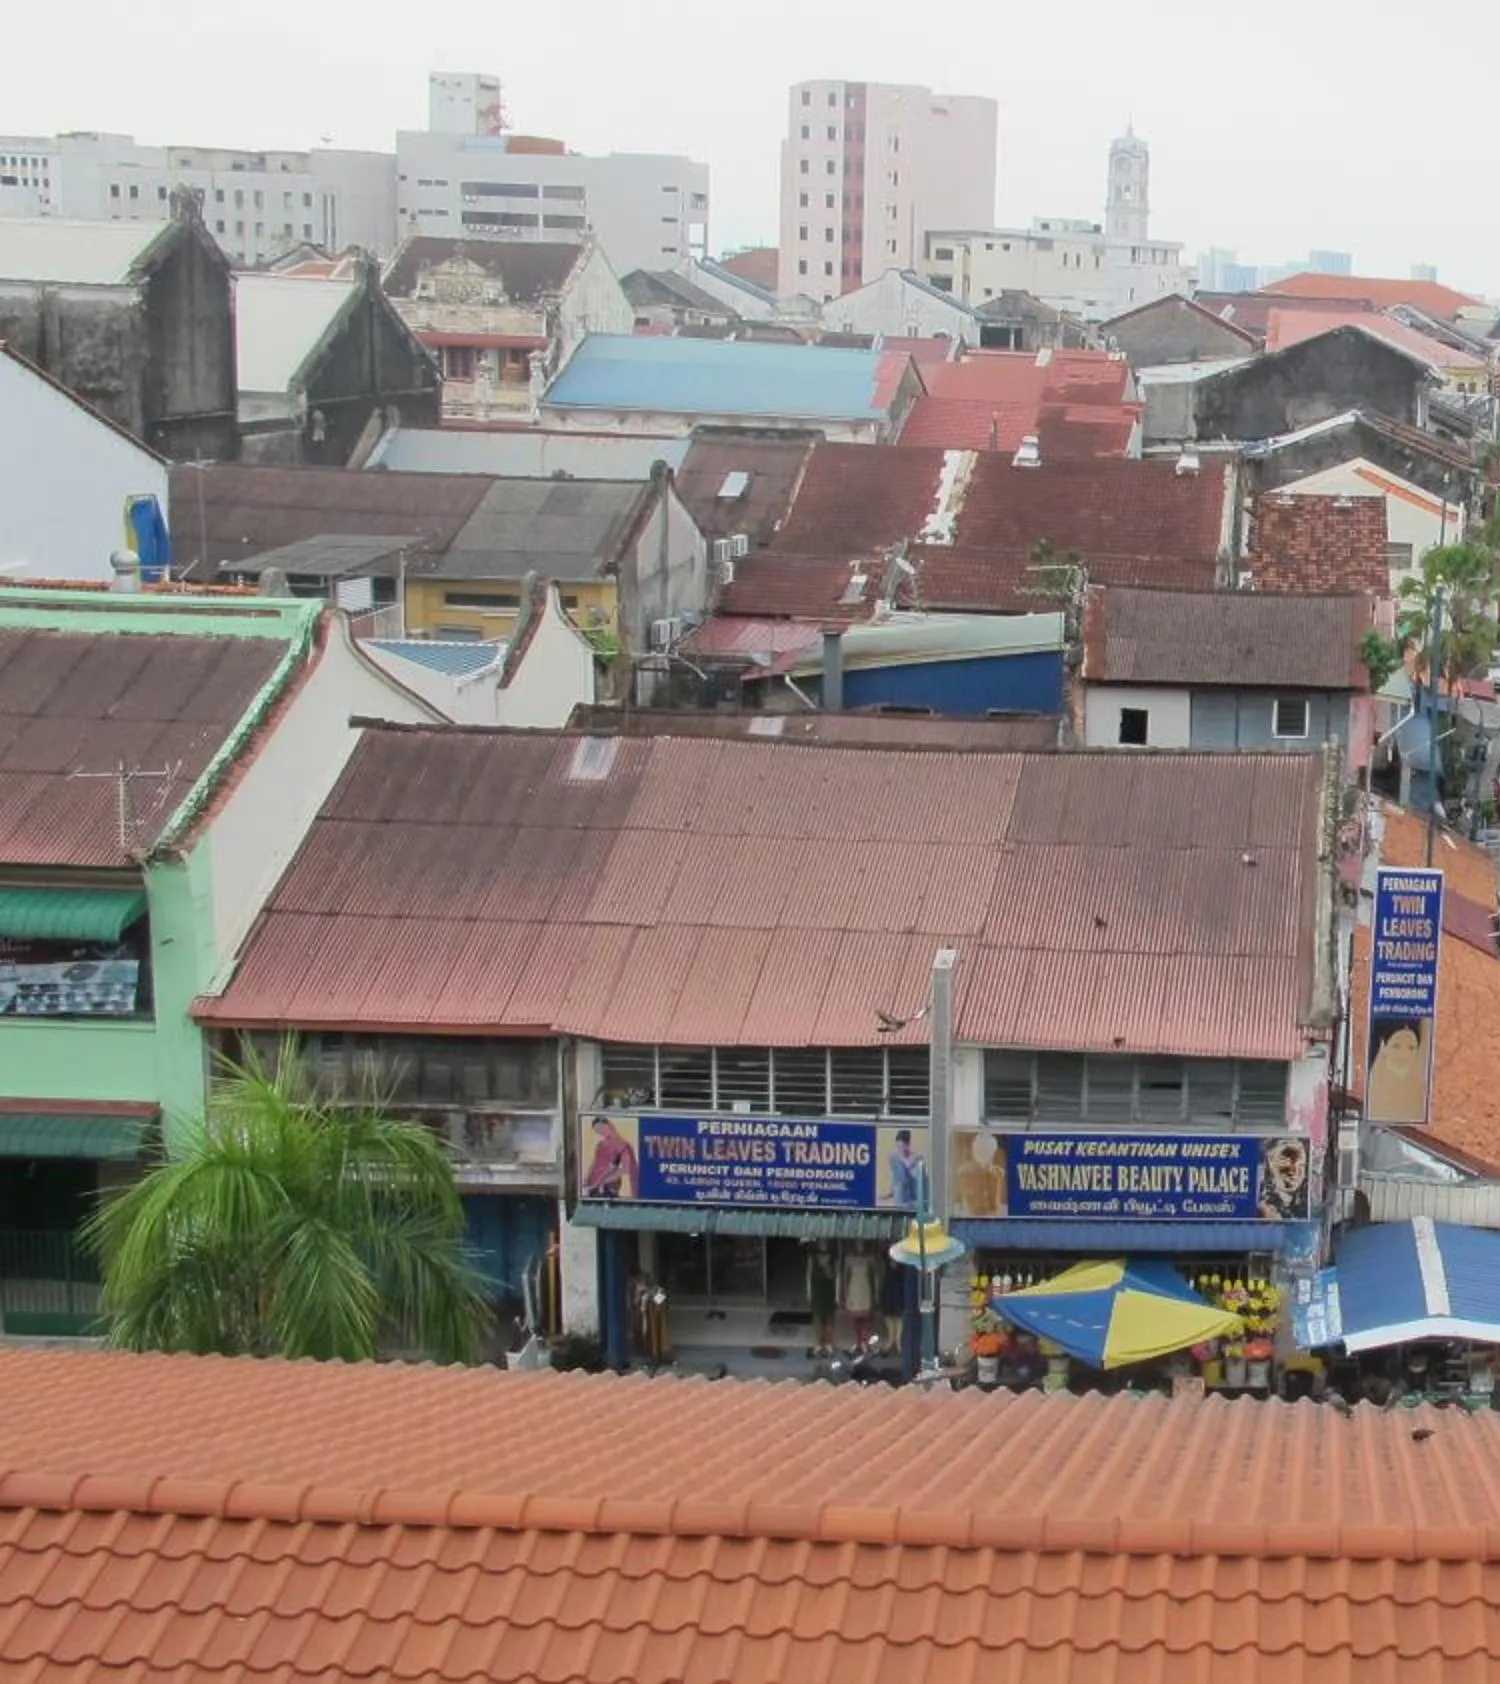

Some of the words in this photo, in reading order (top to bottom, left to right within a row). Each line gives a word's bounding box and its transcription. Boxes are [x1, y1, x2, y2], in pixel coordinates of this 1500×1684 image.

[1392, 895, 1425, 915] TWIN
[1383, 918, 1433, 938] LEAVES
[1377, 941, 1435, 961] TRADING
[697, 1121, 817, 1138] PERNIAGAAN
[645, 1136, 696, 1161] TWIN
[702, 1138, 777, 1163] LEAVES
[782, 1142, 871, 1166] TRADING
[1023, 1140, 1075, 1156] PUSAT
[1075, 1141, 1177, 1157] KECANTIKAN
[1181, 1143, 1241, 1158] UNISEX
[659, 1163, 730, 1176] PERUNCIT
[734, 1166, 763, 1177] DAN
[767, 1167, 855, 1180] PEMBORONG
[1016, 1163, 1113, 1192] VASHNAVEE
[1117, 1165, 1184, 1193] BEAUTY
[1188, 1166, 1249, 1194] PALACE
